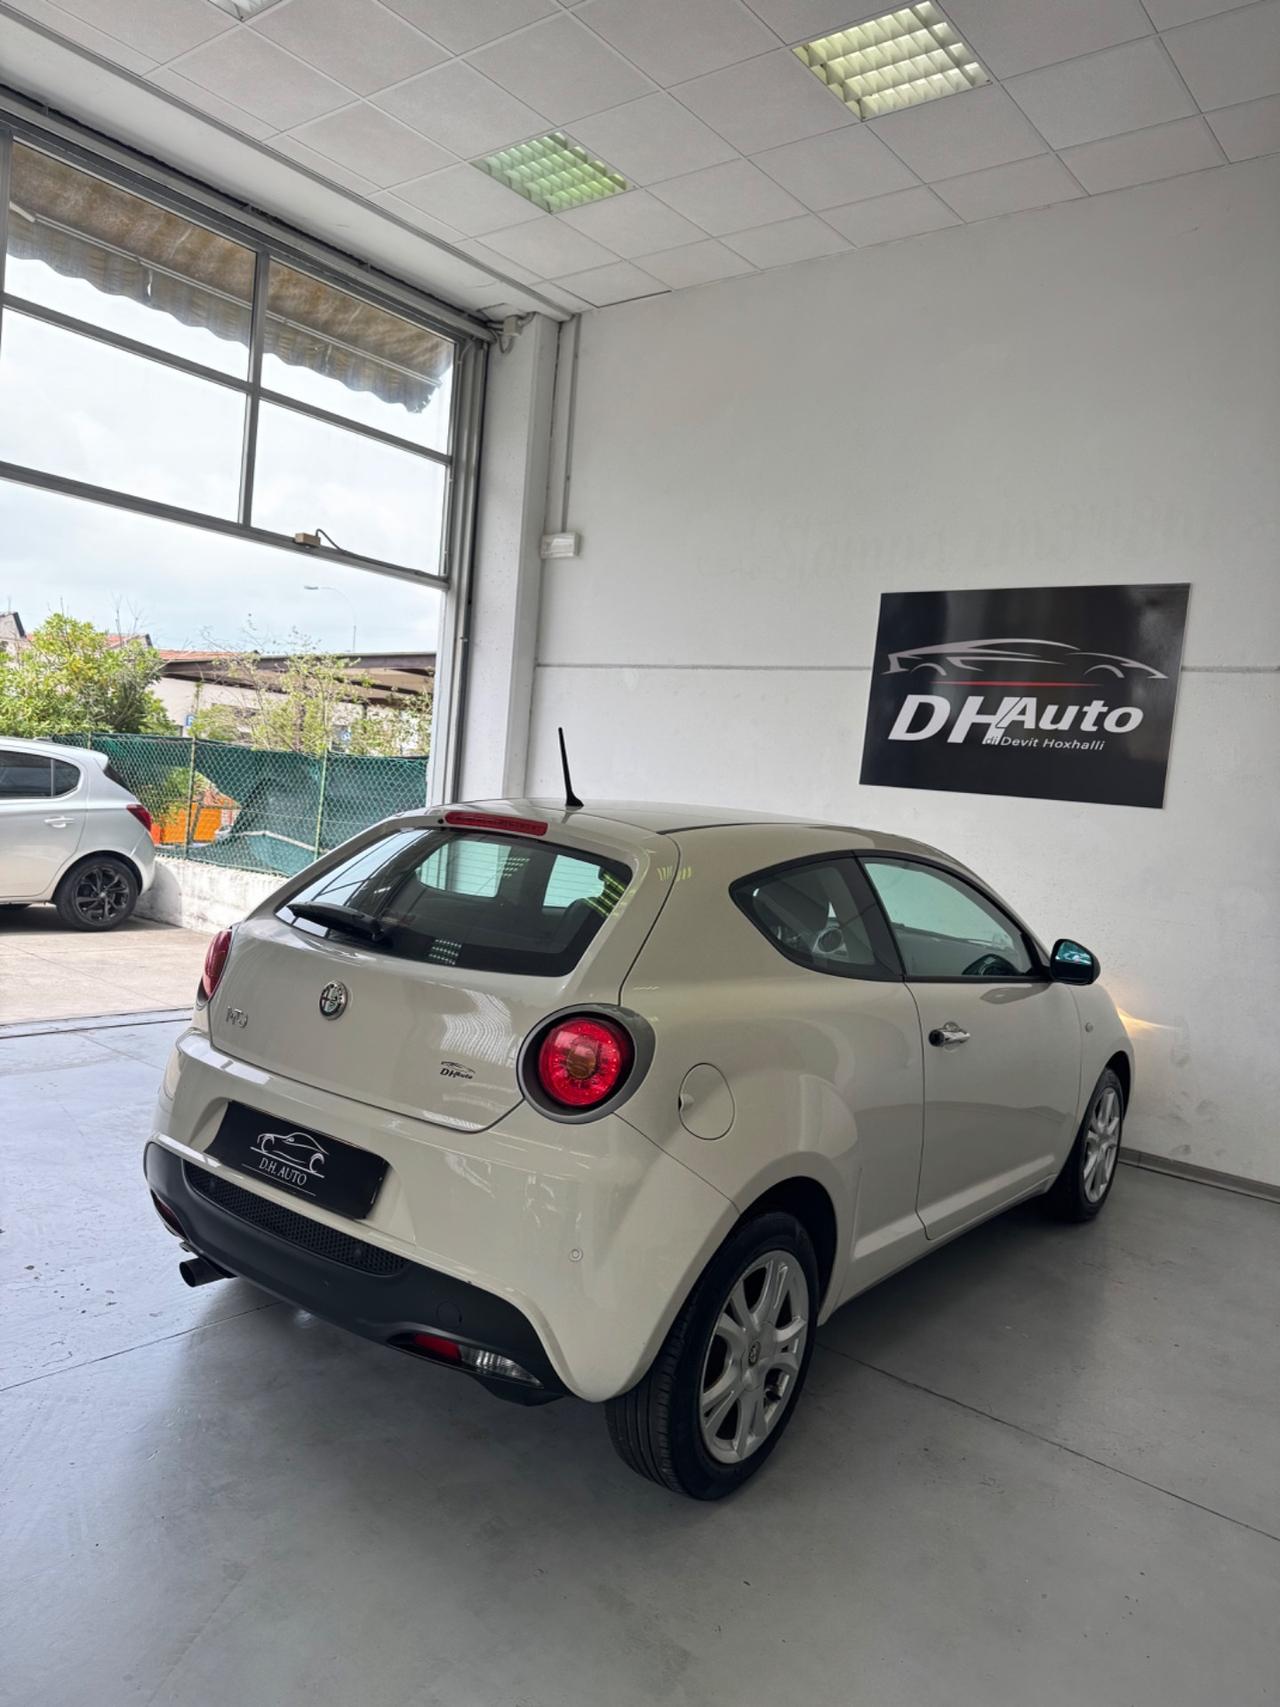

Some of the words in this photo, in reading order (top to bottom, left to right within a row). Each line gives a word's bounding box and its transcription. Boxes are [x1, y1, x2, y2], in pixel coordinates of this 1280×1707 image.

[1000, 736, 1039, 747] Devit
[1043, 739, 1105, 750] Hoxhalli
[277, 1166, 307, 1186] AUTO
